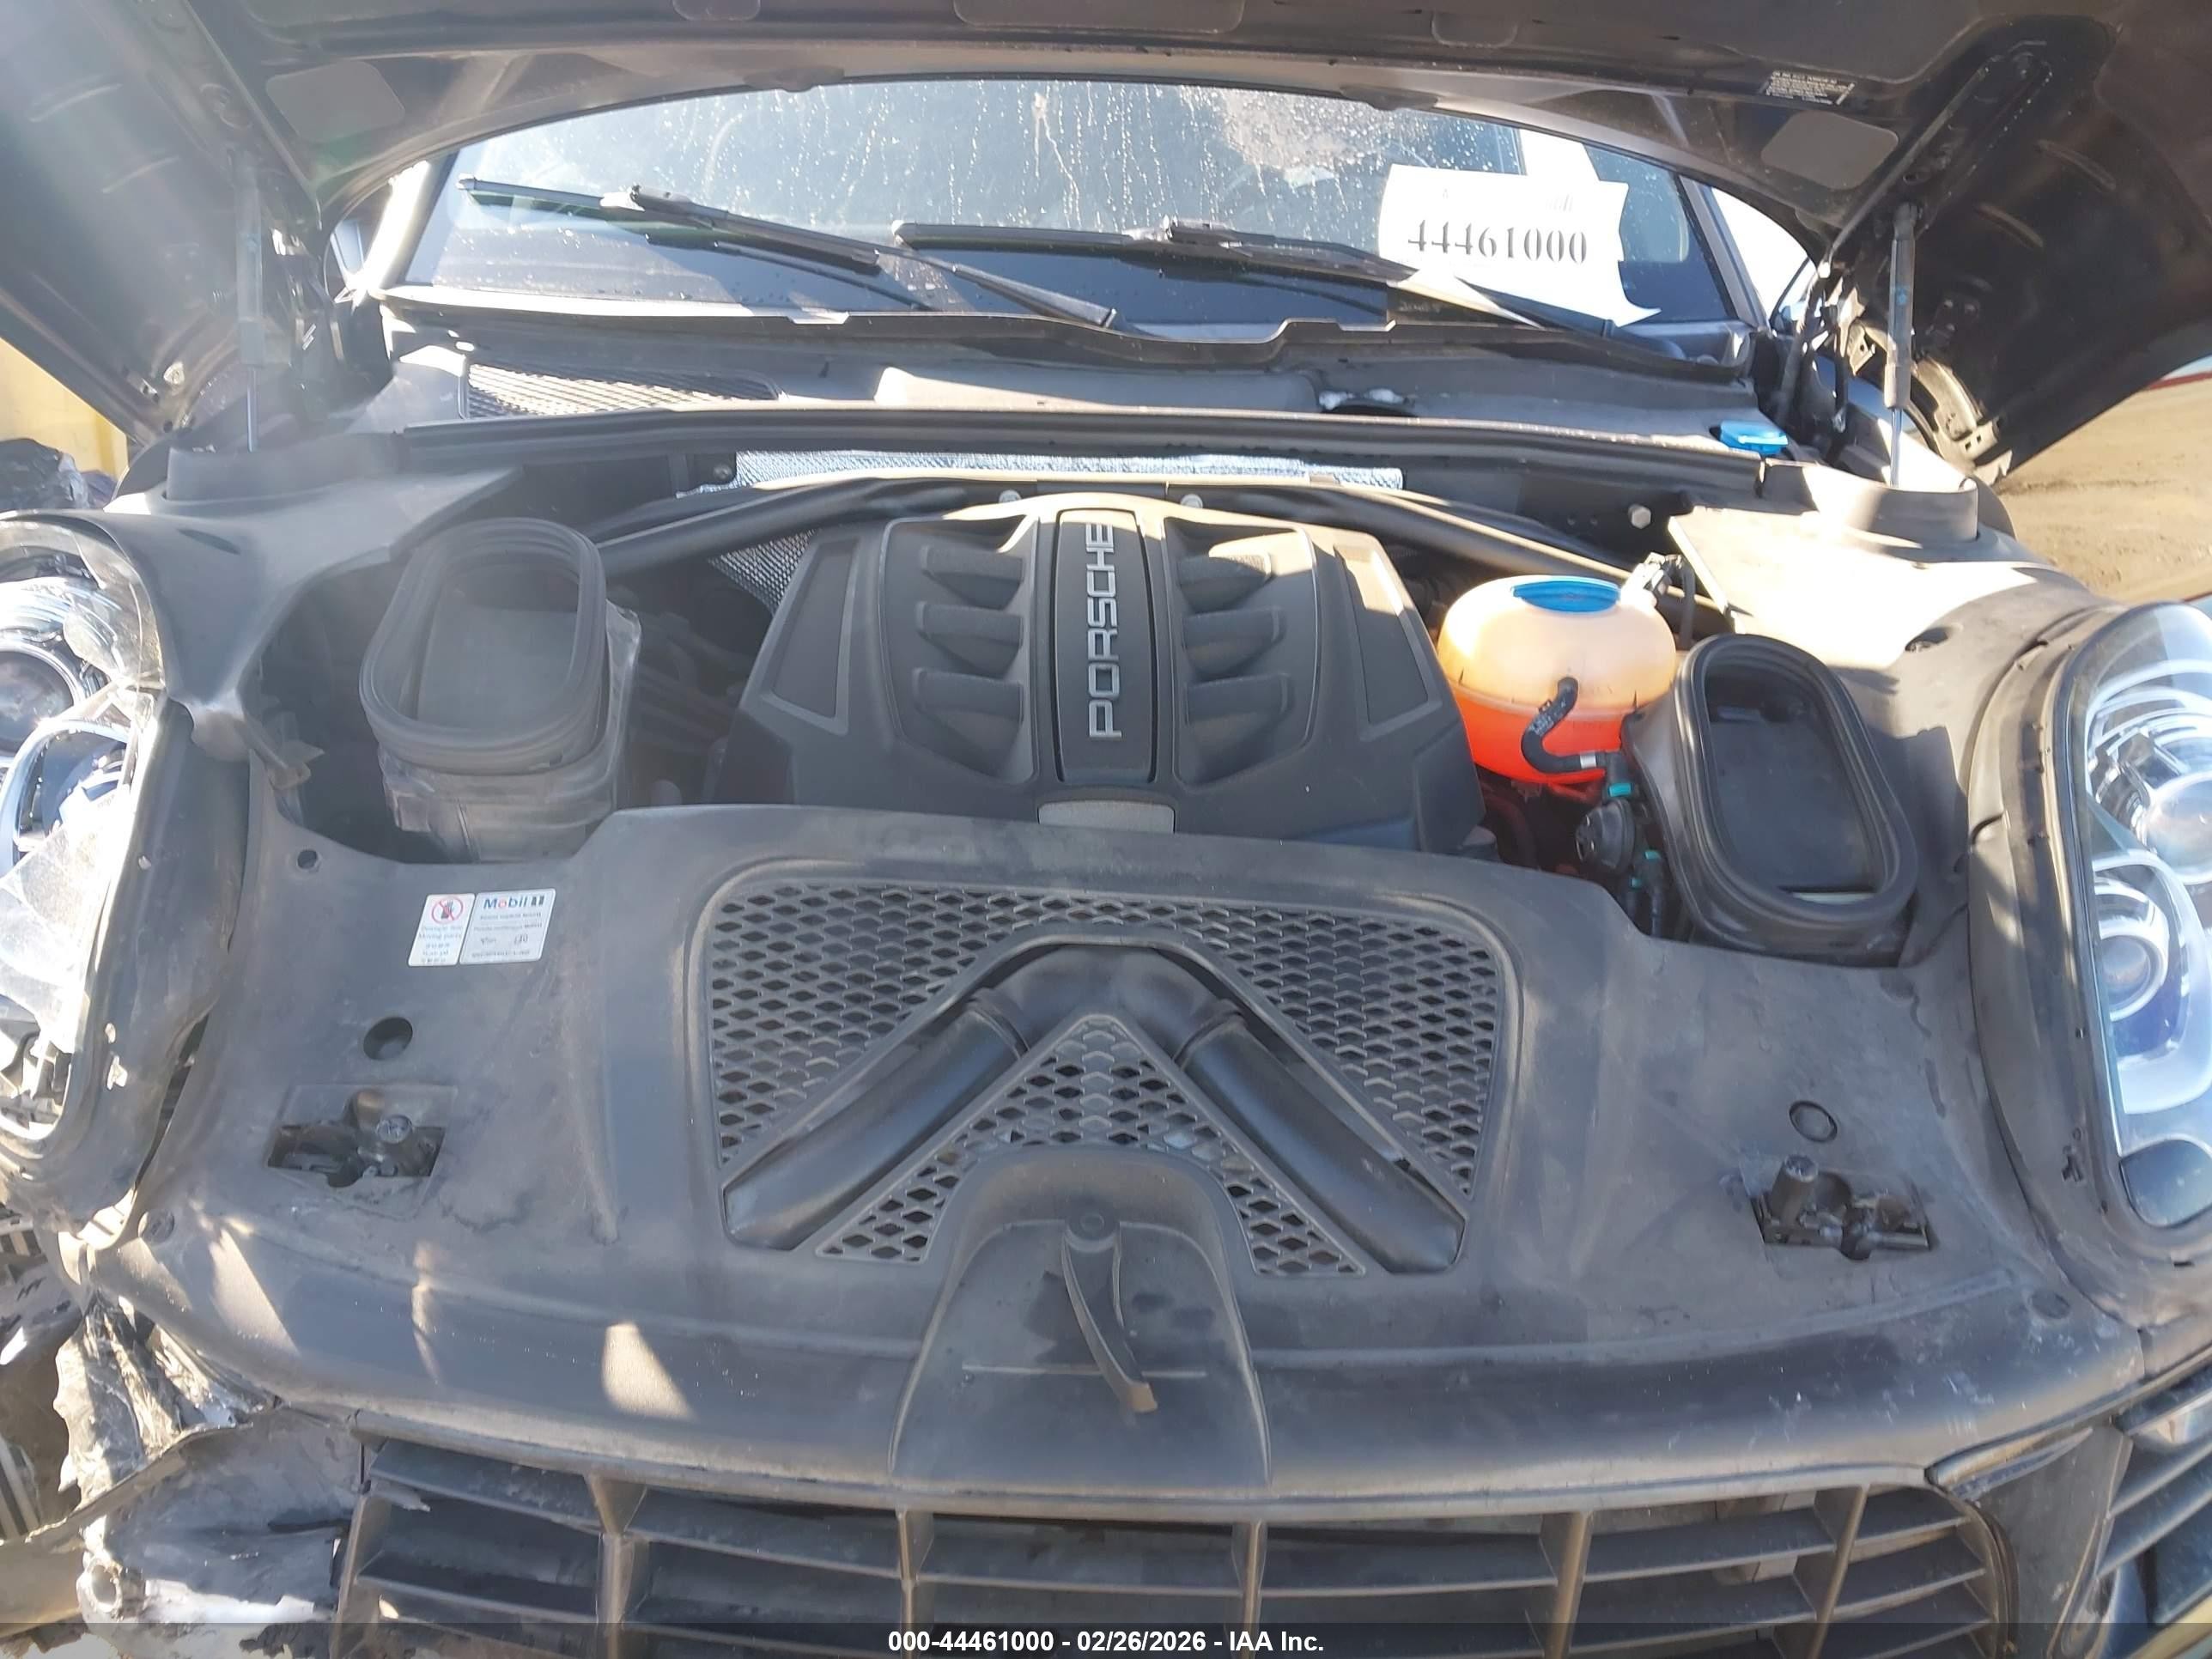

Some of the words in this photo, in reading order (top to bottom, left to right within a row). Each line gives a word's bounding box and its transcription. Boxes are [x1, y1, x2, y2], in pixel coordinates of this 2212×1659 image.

[1407, 219, 1588, 264] 44461000
[1084, 522, 1122, 739] PORSCHE
[483, 895, 527, 909] Mobil
